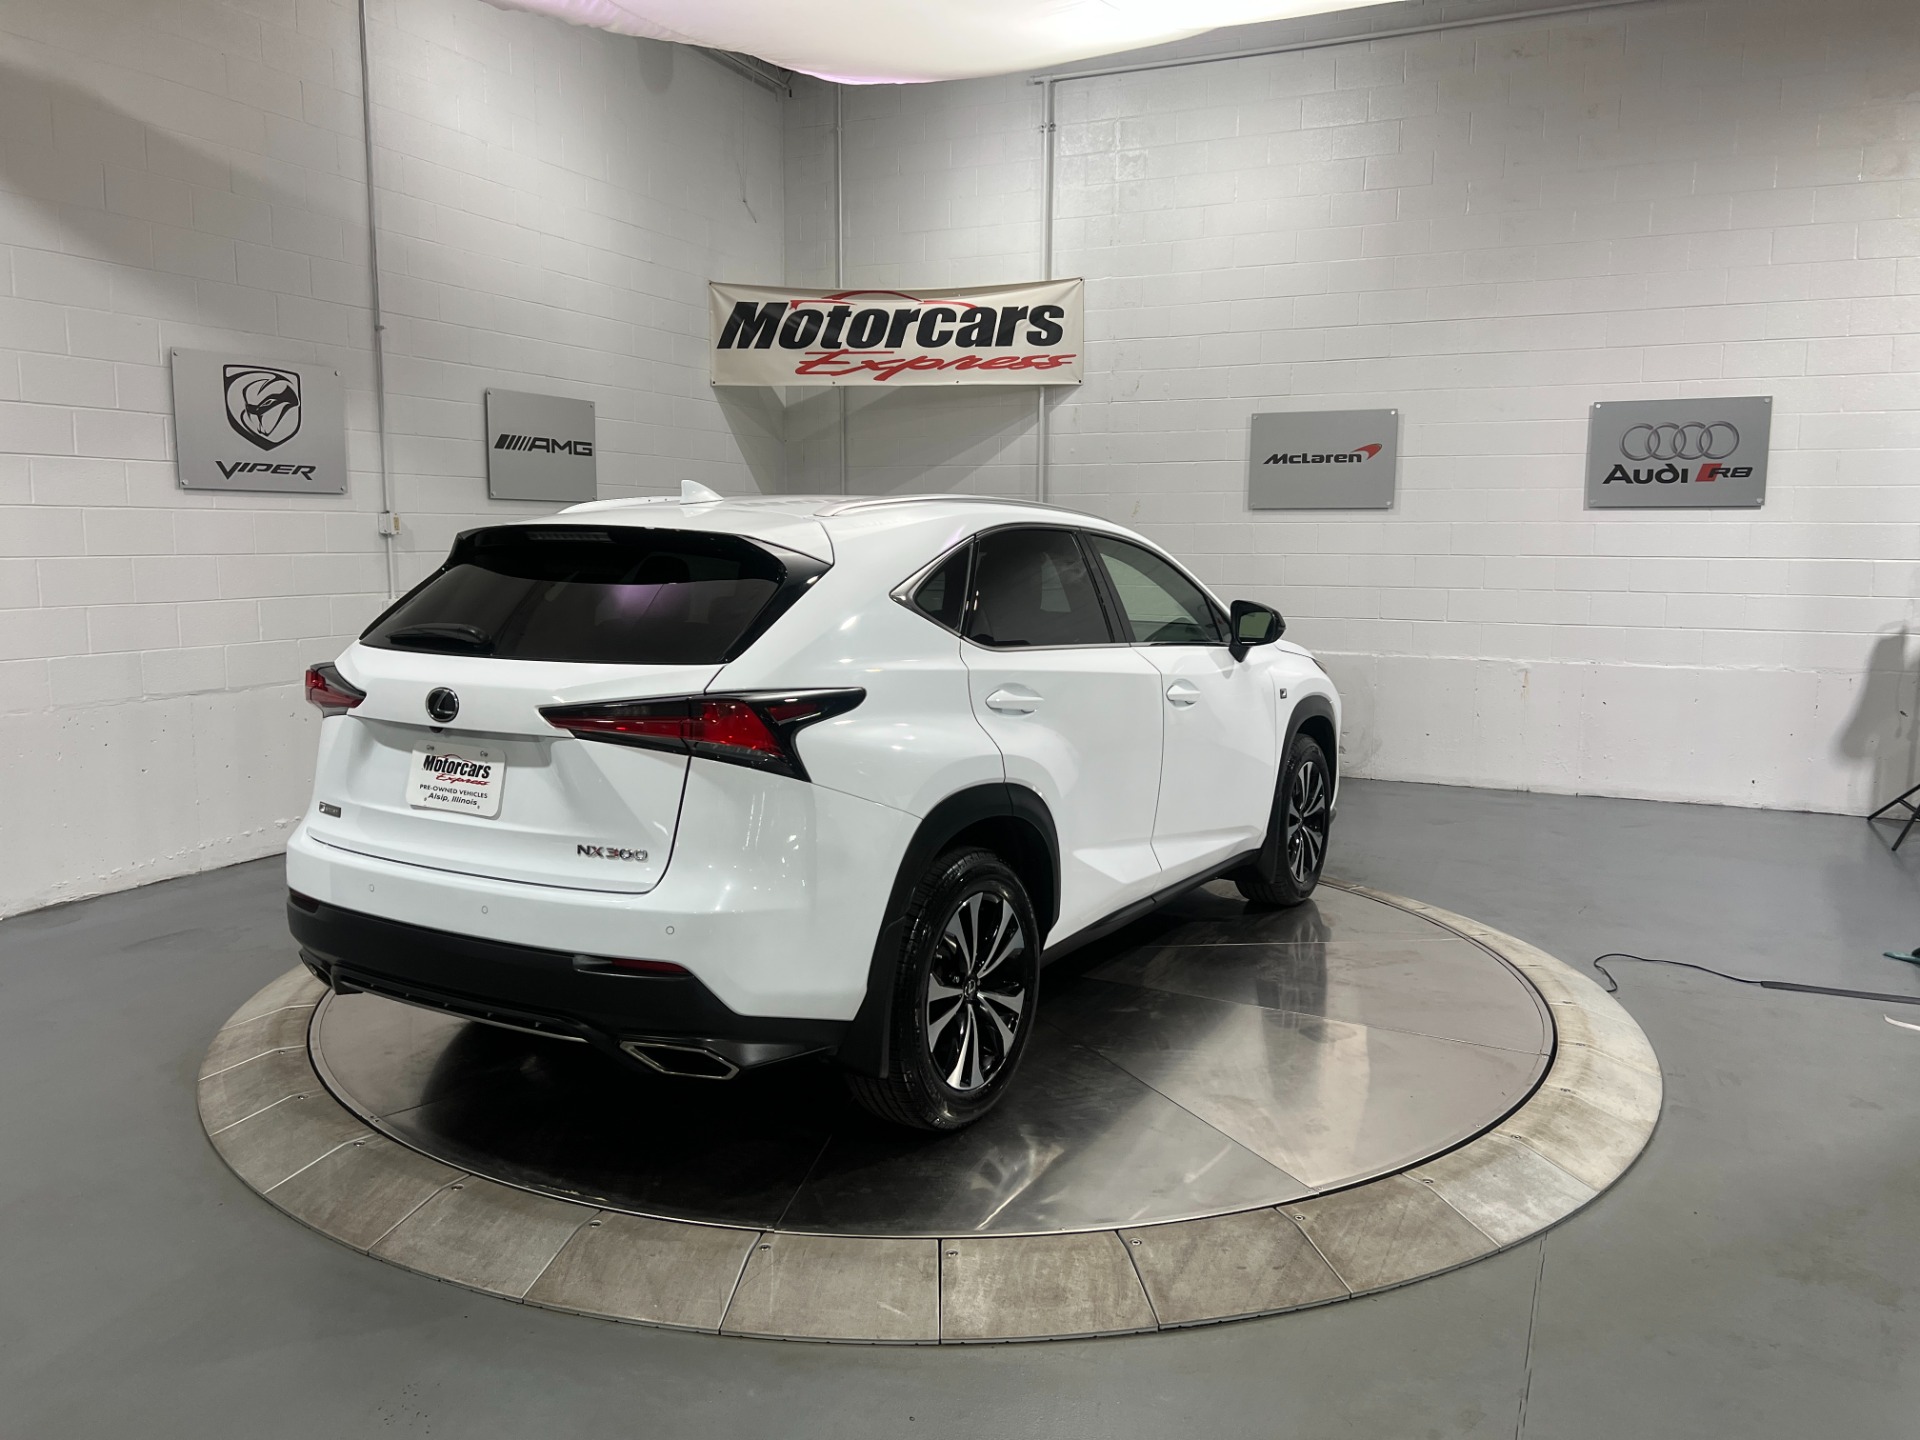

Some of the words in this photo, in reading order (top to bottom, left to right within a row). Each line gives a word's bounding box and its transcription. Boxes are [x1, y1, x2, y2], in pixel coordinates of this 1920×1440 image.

[716, 300, 1065, 350] Motorcars
[794, 348, 1077, 382] Express
[527, 435, 594, 457] AMG
[1263, 452, 1363, 465] McLaren
[1601, 463, 1689, 485] Audi
[1704, 465, 1753, 480] R8
[423, 755, 491, 779] Motorcars
[436, 773, 490, 785] Express
[420, 784, 457, 794] PRE-OWNED
[459, 789, 488, 798] VEHICLES
[428, 793, 450, 802] Alsip,
[452, 796, 477, 805] Illinois
[577, 844, 604, 859] NX
[605, 847, 648, 862] 300
